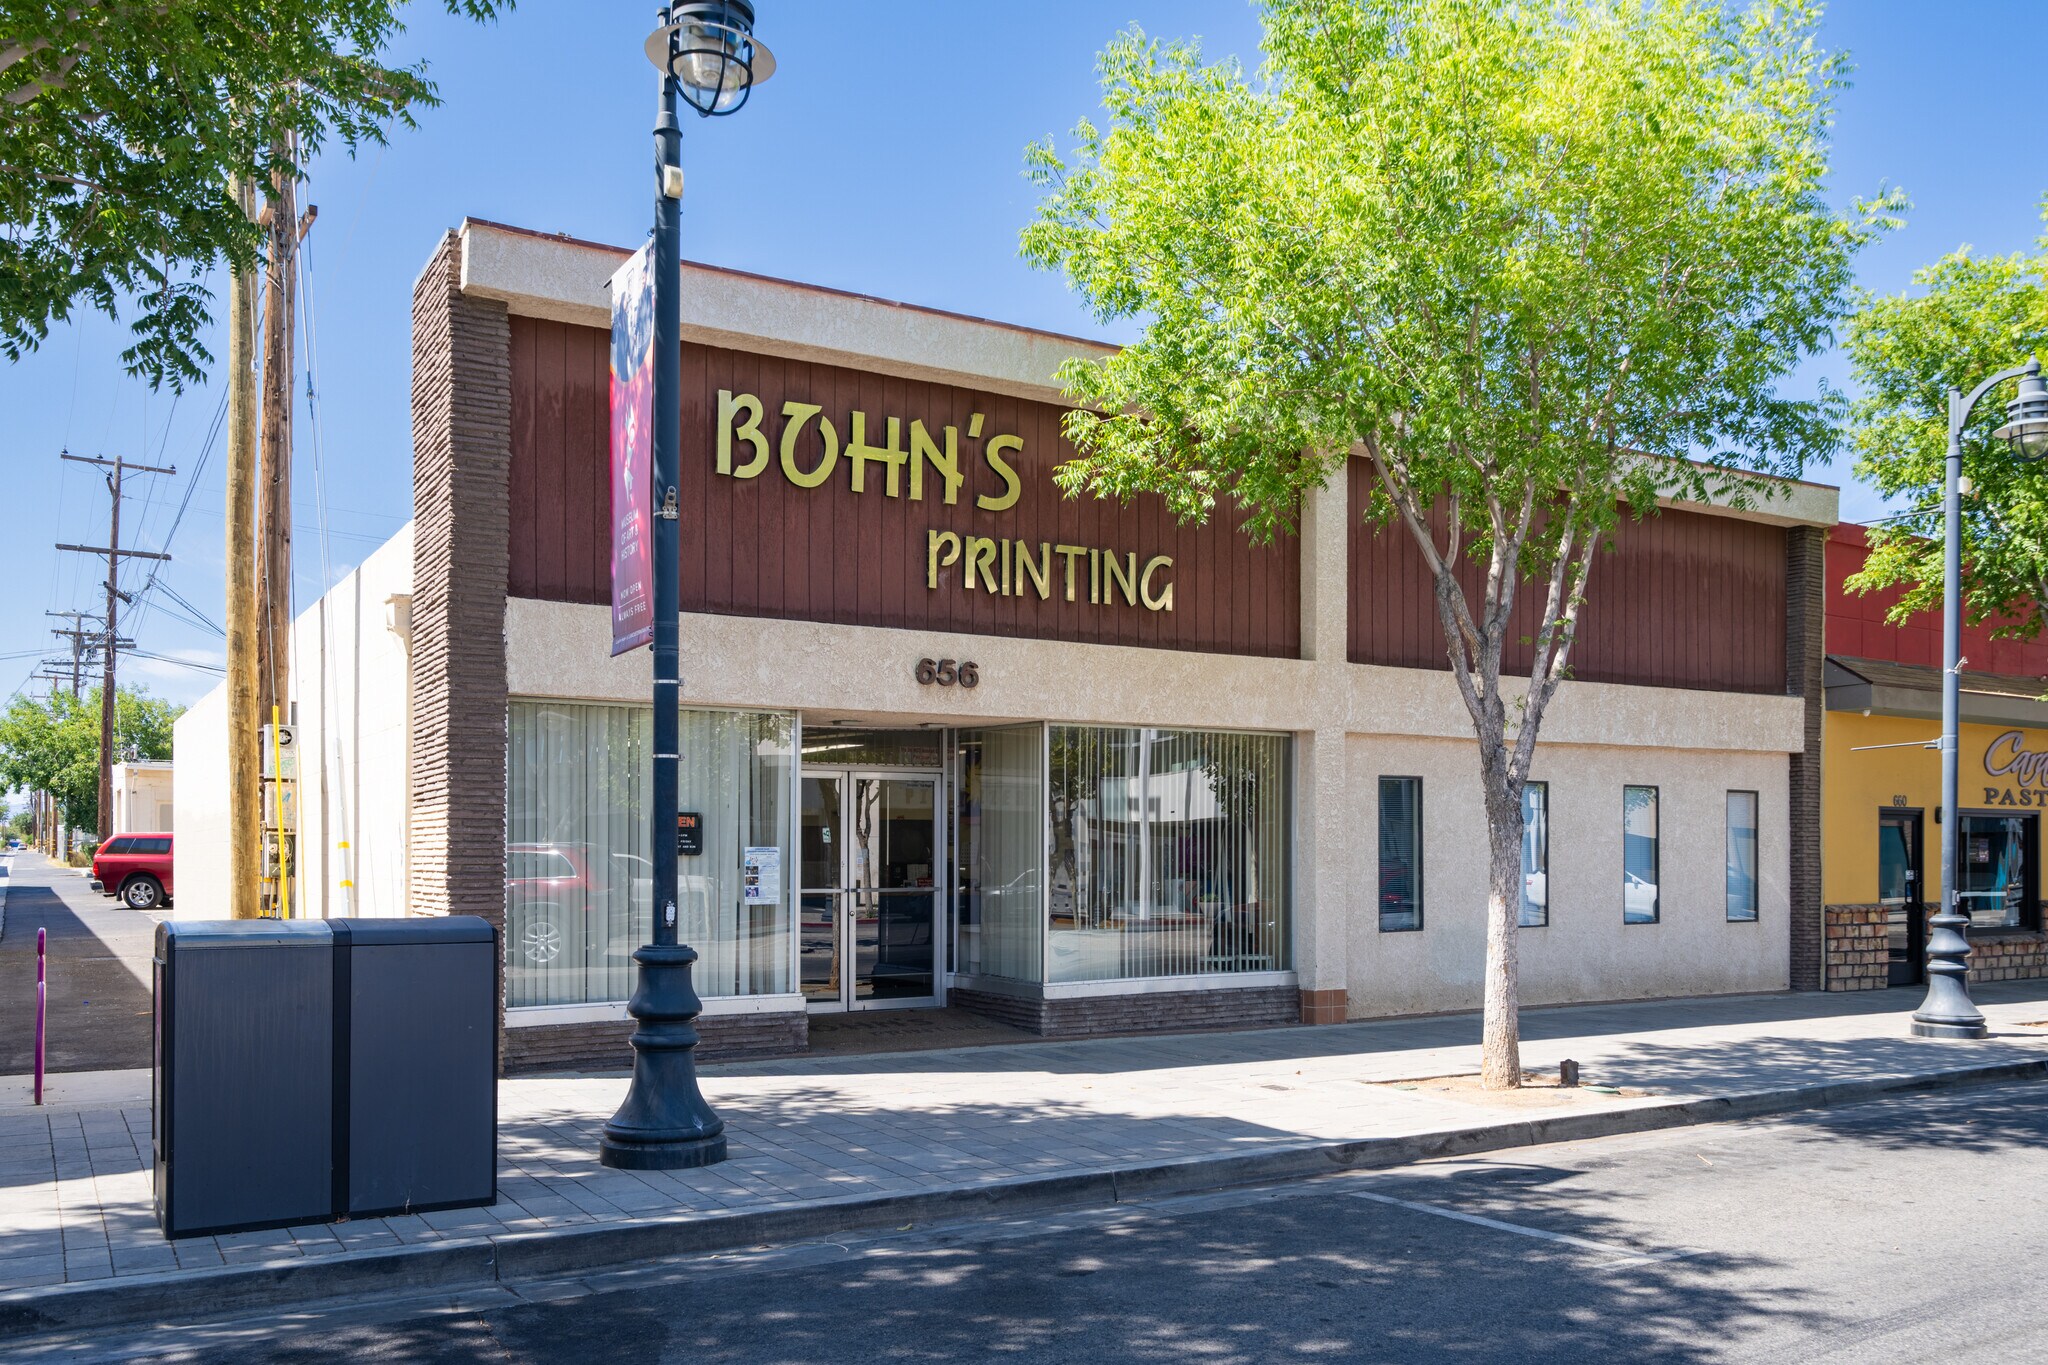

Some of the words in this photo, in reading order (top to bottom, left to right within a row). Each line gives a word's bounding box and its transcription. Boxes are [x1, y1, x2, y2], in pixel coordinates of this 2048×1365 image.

[716, 389, 1024, 511] BOHN'S
[621, 508, 639, 529] MUSEUM
[621, 531, 627, 545] OF
[621, 540, 639, 561] HISTORY
[928, 529, 1173, 612] PRINTING
[620, 587, 629, 600] NOW
[630, 581, 642, 595] OPEN
[618, 607, 634, 621] ALWAYS
[635, 601, 647, 614] FREE
[915, 657, 979, 688] 656
[1893, 794, 1907, 807] 660
[1983, 787, 2048, 807] PAST
[678, 816, 695, 828] EN
